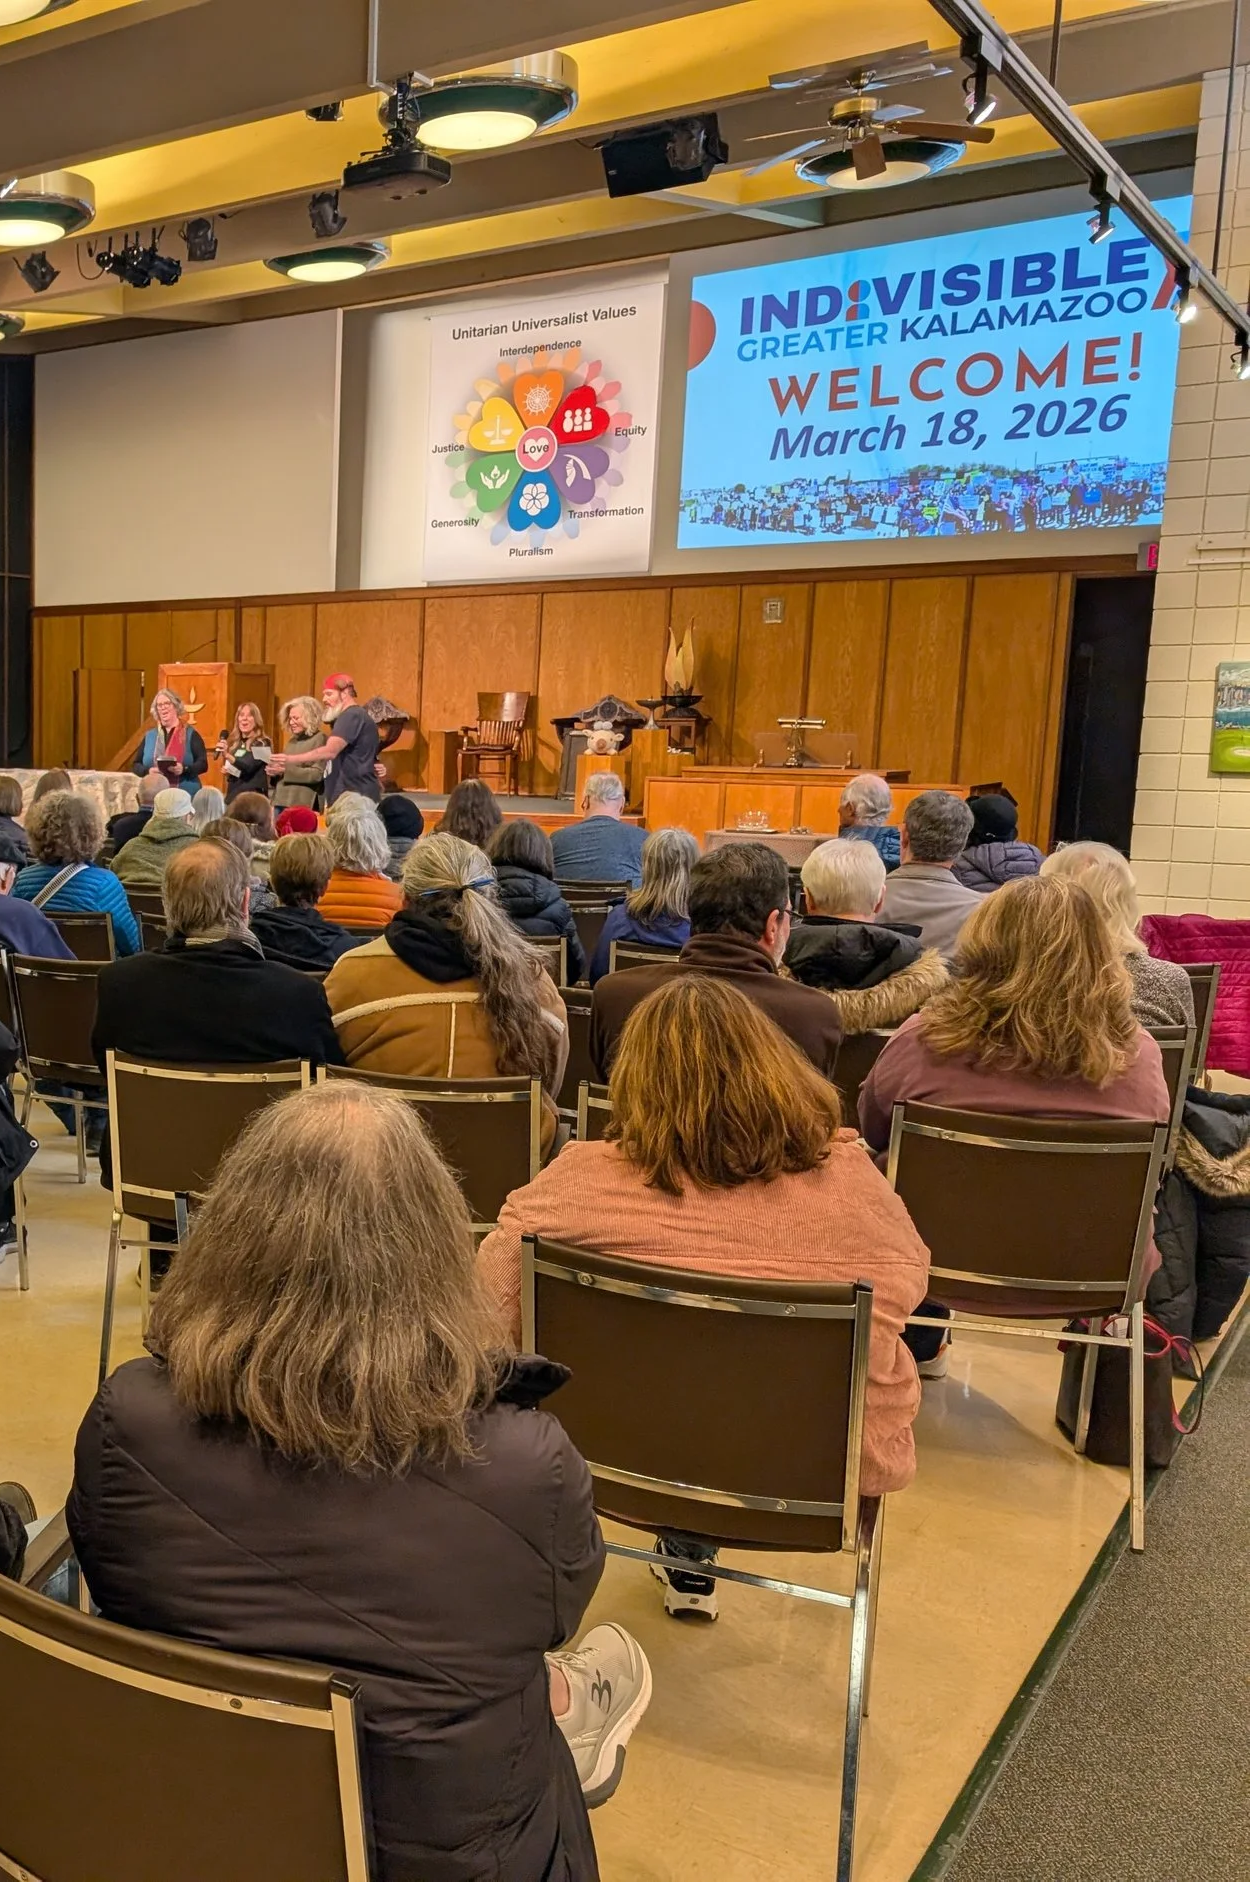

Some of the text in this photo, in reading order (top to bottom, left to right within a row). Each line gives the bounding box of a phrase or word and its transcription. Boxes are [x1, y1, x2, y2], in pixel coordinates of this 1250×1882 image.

[452, 304, 637, 341] Unitarian Universalist Values
[737, 286, 1148, 362] GREATER KALAMAZOO
[499, 339, 582, 357] Interdependence
[768, 332, 1142, 417] WELCOME!
[614, 425, 648, 438] Equity
[769, 393, 1132, 461] March 18, 2026
[431, 443, 465, 455] Justice
[522, 443, 550, 454] Love
[568, 506, 644, 520] Transformation
[431, 517, 480, 529] Generosity
[509, 547, 554, 557] Pluralism
